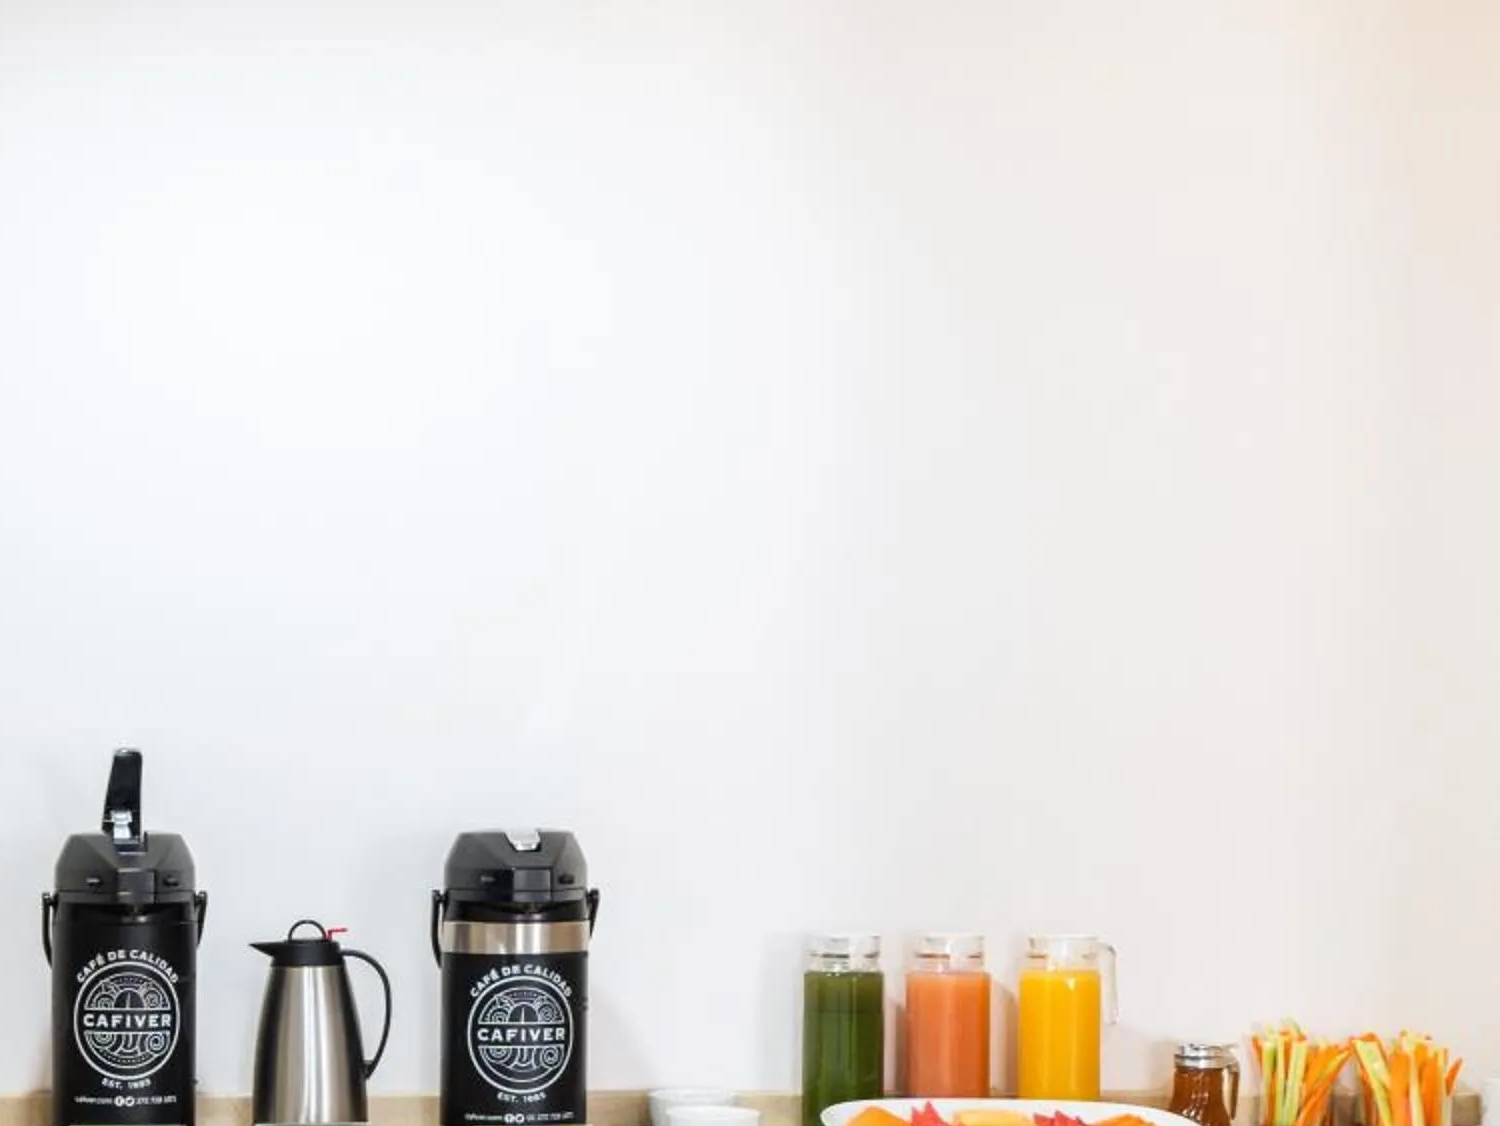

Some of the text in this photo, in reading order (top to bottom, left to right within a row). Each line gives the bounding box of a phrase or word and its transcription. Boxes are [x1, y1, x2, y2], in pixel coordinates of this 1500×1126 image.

[76, 949, 179, 983] CAFÉ DE CALIDAD
[470, 963, 573, 997] CAFÉ DE CALIDAD
[83, 1014, 172, 1028] CAFIVER
[477, 1028, 565, 1042] CAFIVER
